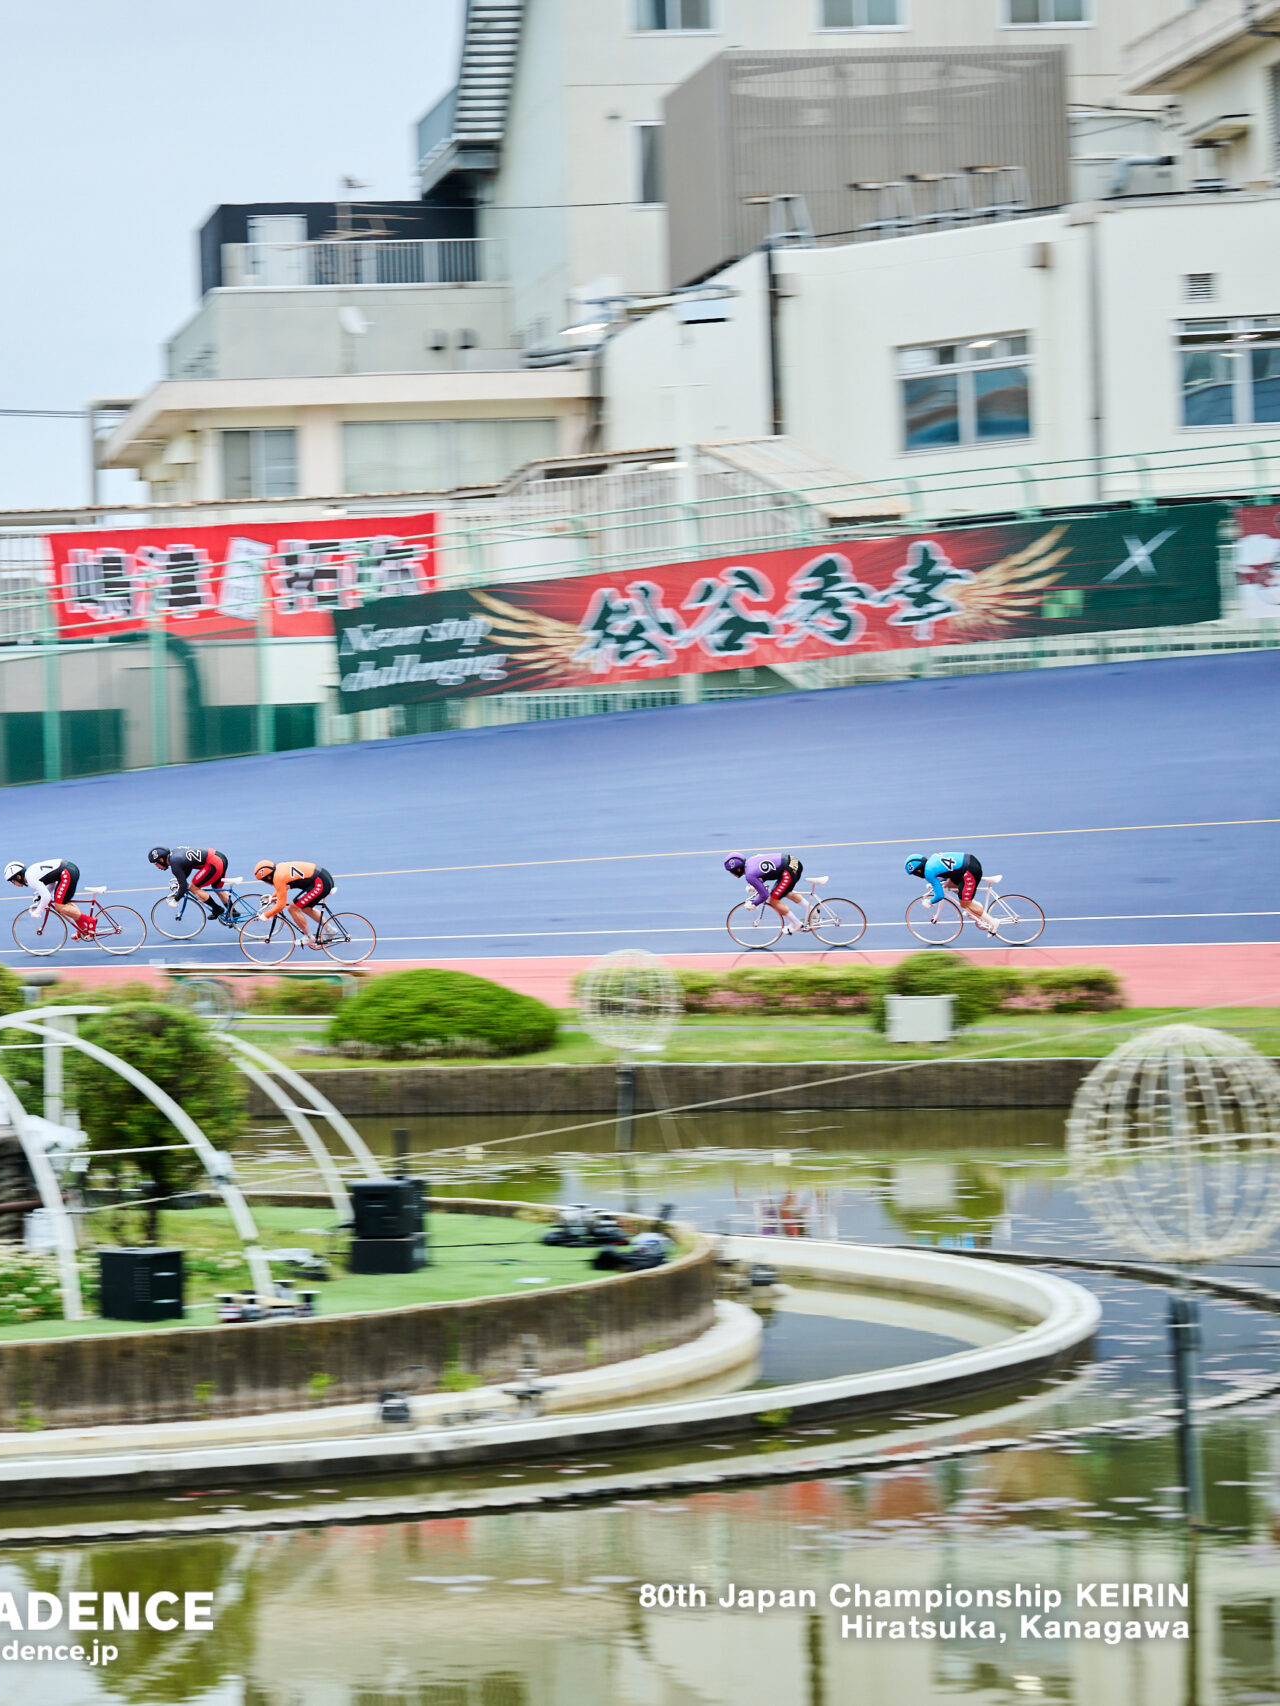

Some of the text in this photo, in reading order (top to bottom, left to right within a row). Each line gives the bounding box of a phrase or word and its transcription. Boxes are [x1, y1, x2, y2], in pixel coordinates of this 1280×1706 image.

[185, 849, 202, 863] 2
[40, 864, 54, 872] 1
[760, 859, 777, 873] 9
[940, 857, 957, 872] 4
[290, 865, 305, 880] 7
